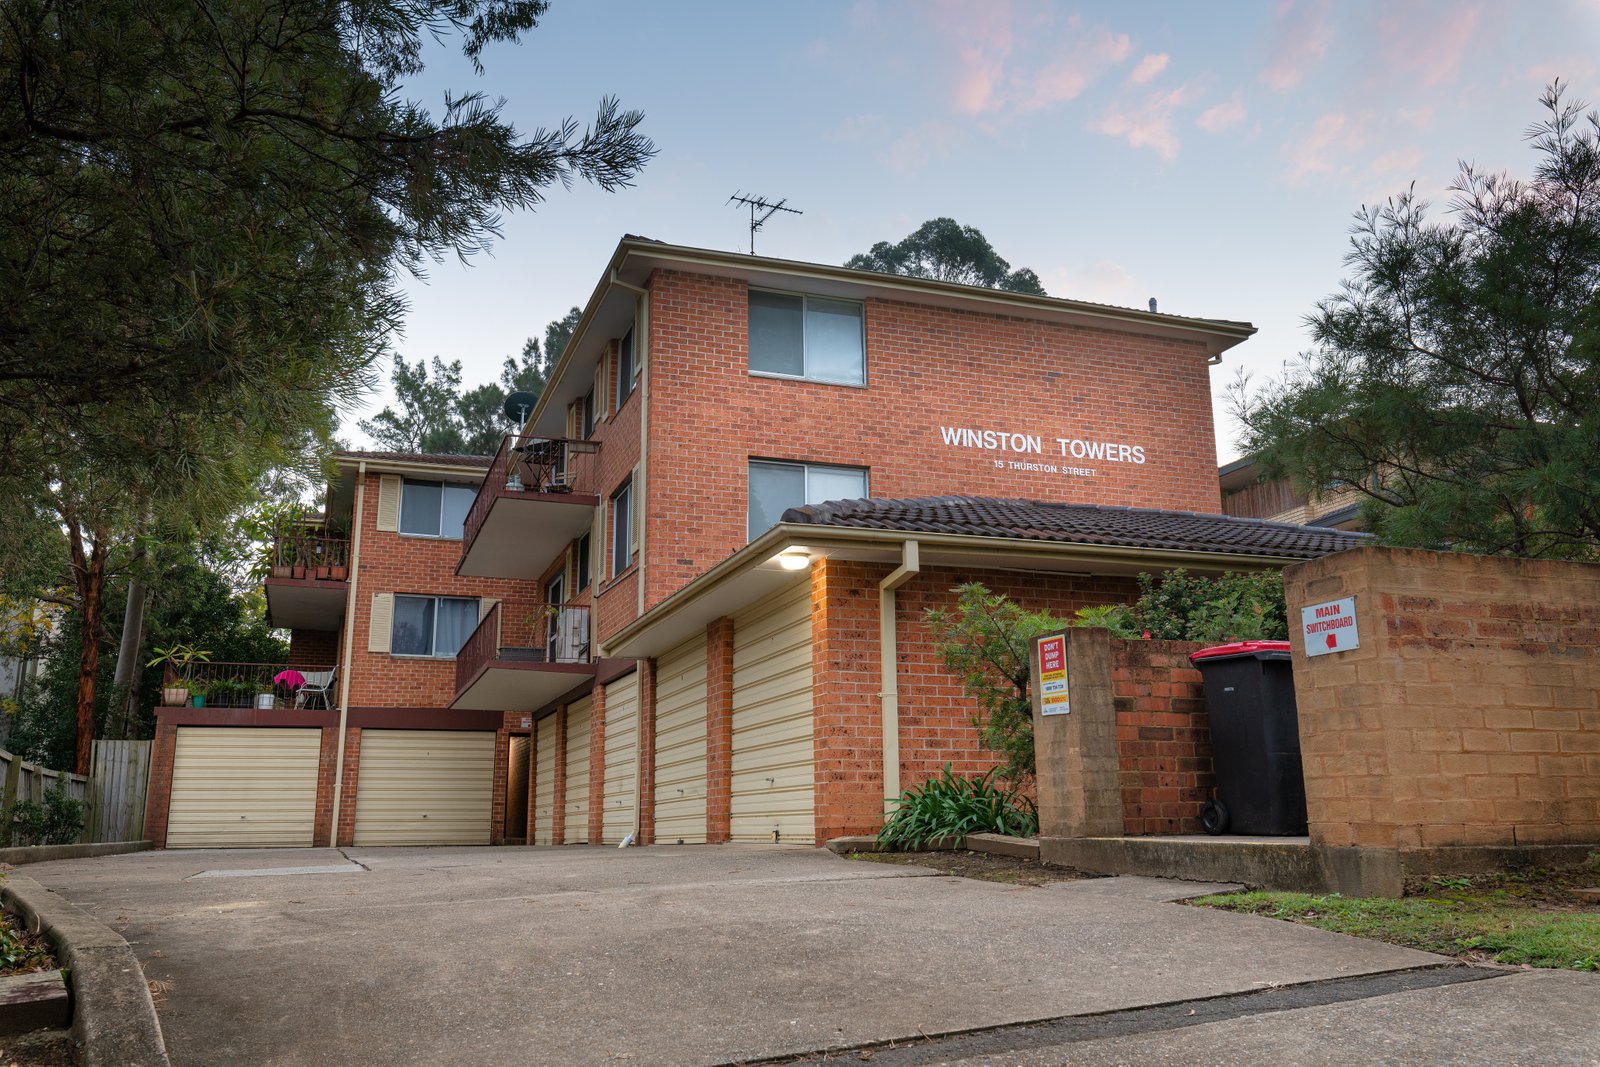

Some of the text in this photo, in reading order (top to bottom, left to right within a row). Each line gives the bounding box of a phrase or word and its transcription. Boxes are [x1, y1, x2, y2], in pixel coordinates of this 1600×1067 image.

[940, 426, 1146, 464] WINSTON TOWERS
[994, 460, 1097, 477] 15 THURSTON STREET
[1315, 604, 1341, 619] MAIN
[1306, 616, 1353, 634] SWITCHBOARD
[1044, 641, 1059, 651] DON'T
[1045, 651, 1059, 660] DUMP
[1046, 660, 1059, 669] HERE
